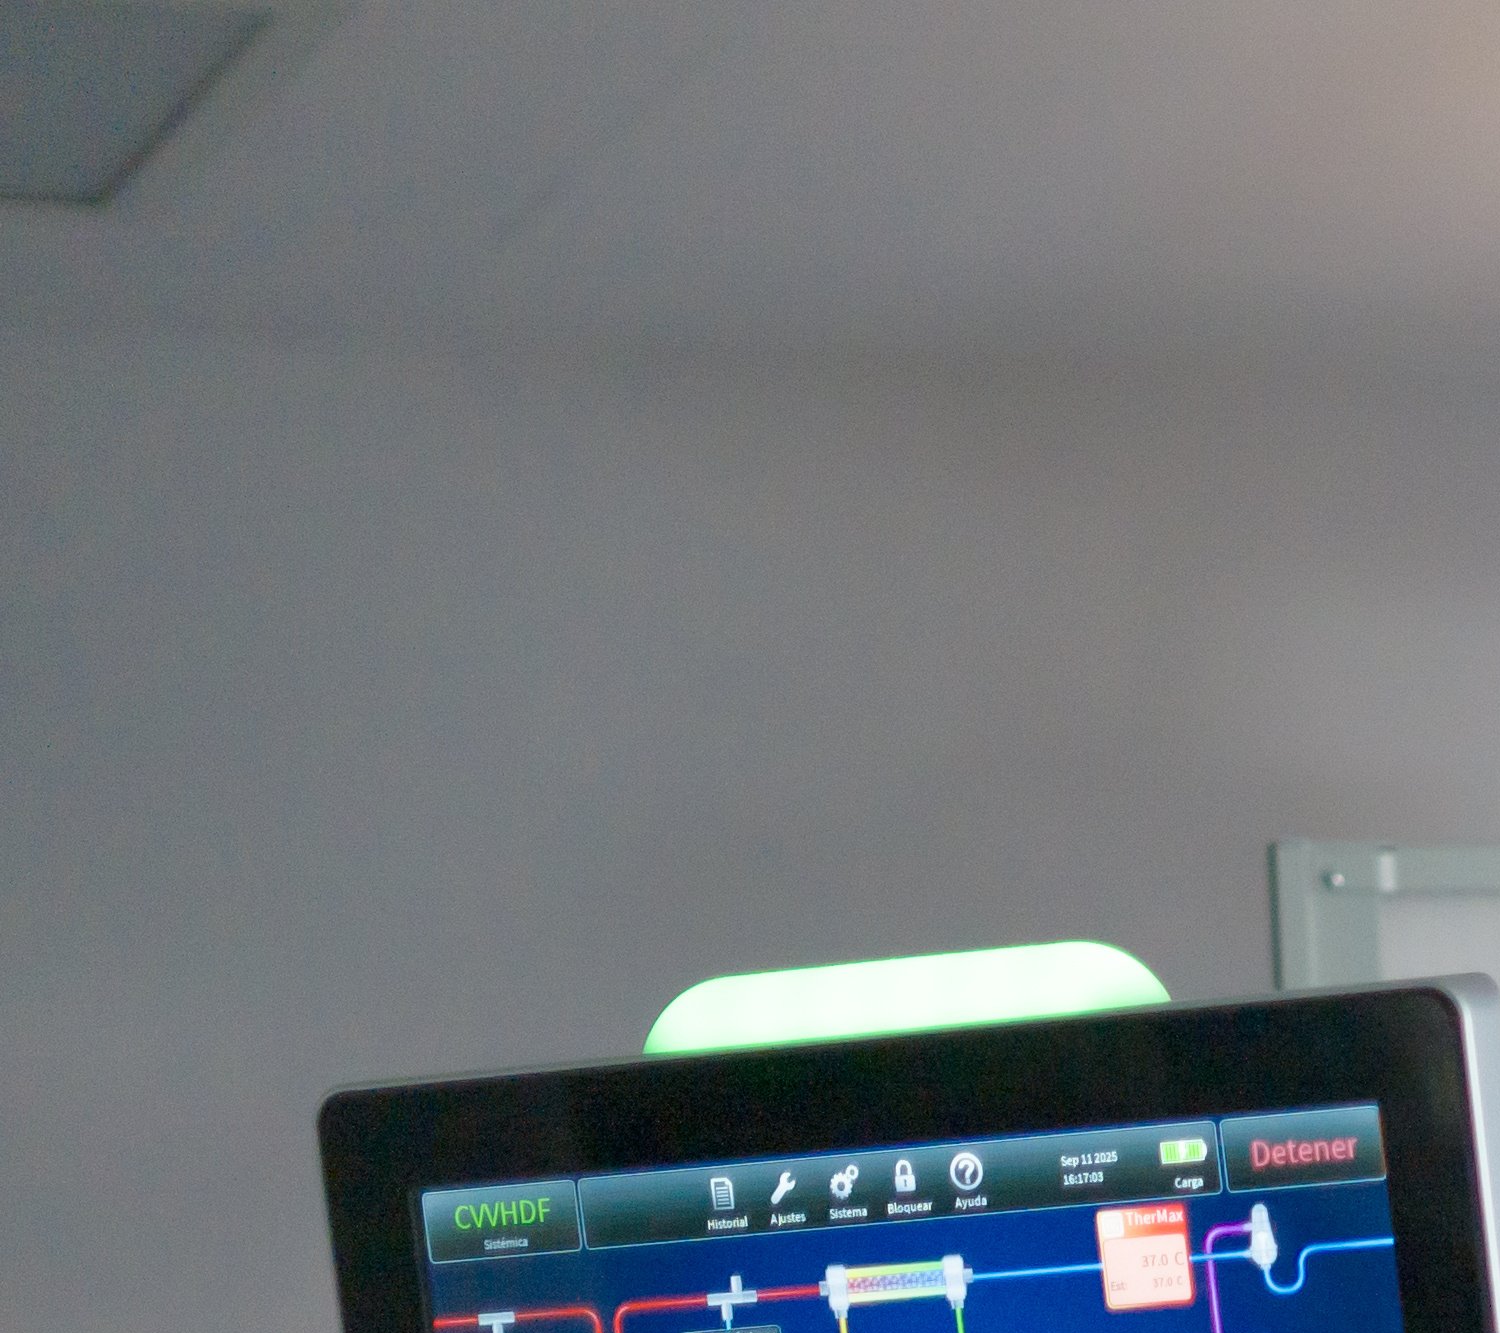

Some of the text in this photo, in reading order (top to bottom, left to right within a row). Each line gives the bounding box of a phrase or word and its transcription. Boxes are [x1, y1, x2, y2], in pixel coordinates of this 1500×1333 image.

[1251, 1136, 1358, 1167] Detener
[1061, 1152, 1118, 1169] Sep 11 2025
[1063, 1172, 1104, 1186] 16:17:03
[1175, 1177, 1204, 1191] Carga
[887, 1201, 933, 1215] Bloquear
[955, 1195, 987, 1210] Ayuda
[770, 1212, 806, 1227] Ajustes
[829, 1206, 868, 1220] Sistema
[1126, 1208, 1184, 1226] TherMax
[707, 1216, 748, 1231] Historial
[1142, 1255, 1169, 1268] 37.0
[1153, 1277, 1173, 1288] 37.0
